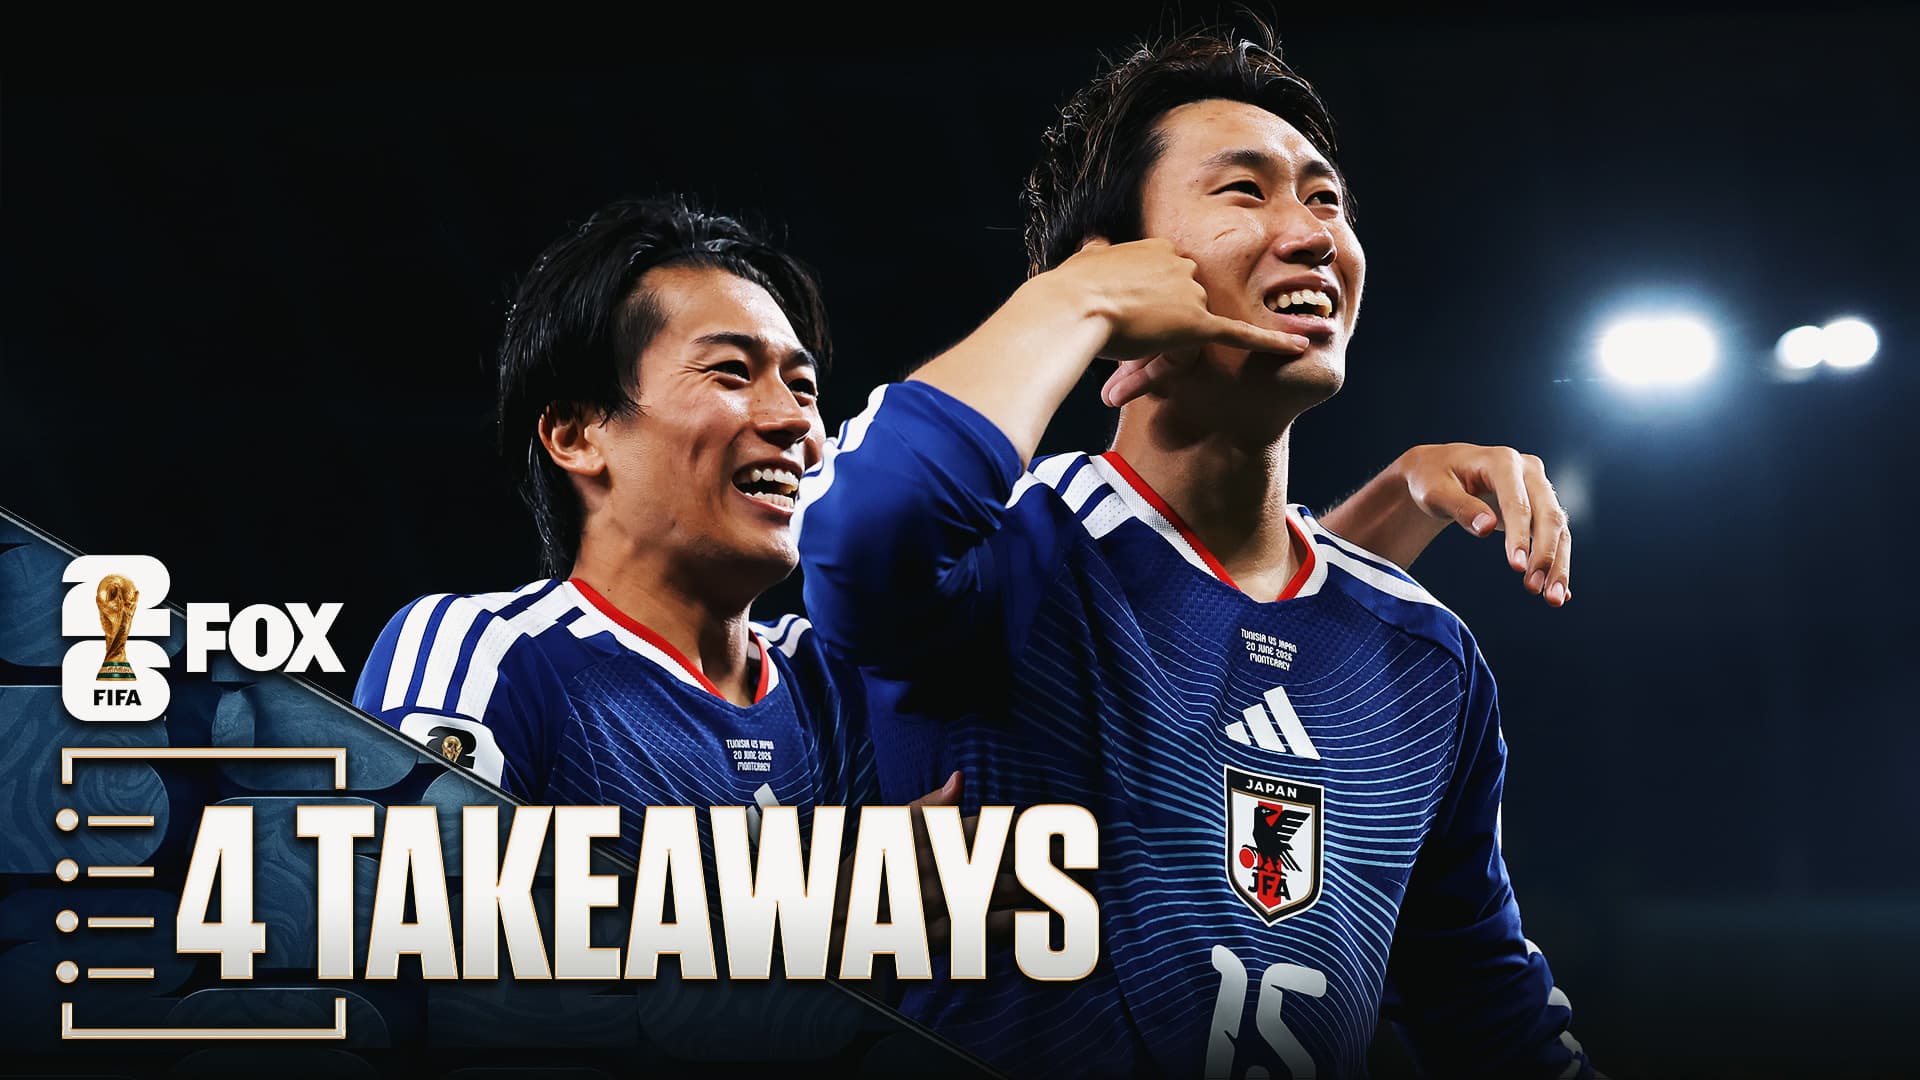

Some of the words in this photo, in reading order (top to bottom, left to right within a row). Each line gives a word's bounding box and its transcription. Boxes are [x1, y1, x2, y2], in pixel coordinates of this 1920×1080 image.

[1241, 628, 1266, 642] TUNISIA
[1279, 640, 1297, 653] JAPAN
[1246, 642, 1255, 651] 20
[1258, 644, 1273, 655] JUNE
[1276, 649, 1292, 661] 2026
[1250, 653, 1290, 671] MONTERREY
[733, 751, 742, 759] 20
[743, 751, 757, 759] JUNE
[1245, 779, 1298, 799] JAPAN
[1247, 871, 1292, 901] JFA
[1203, 943, 1327, 1080] 15
